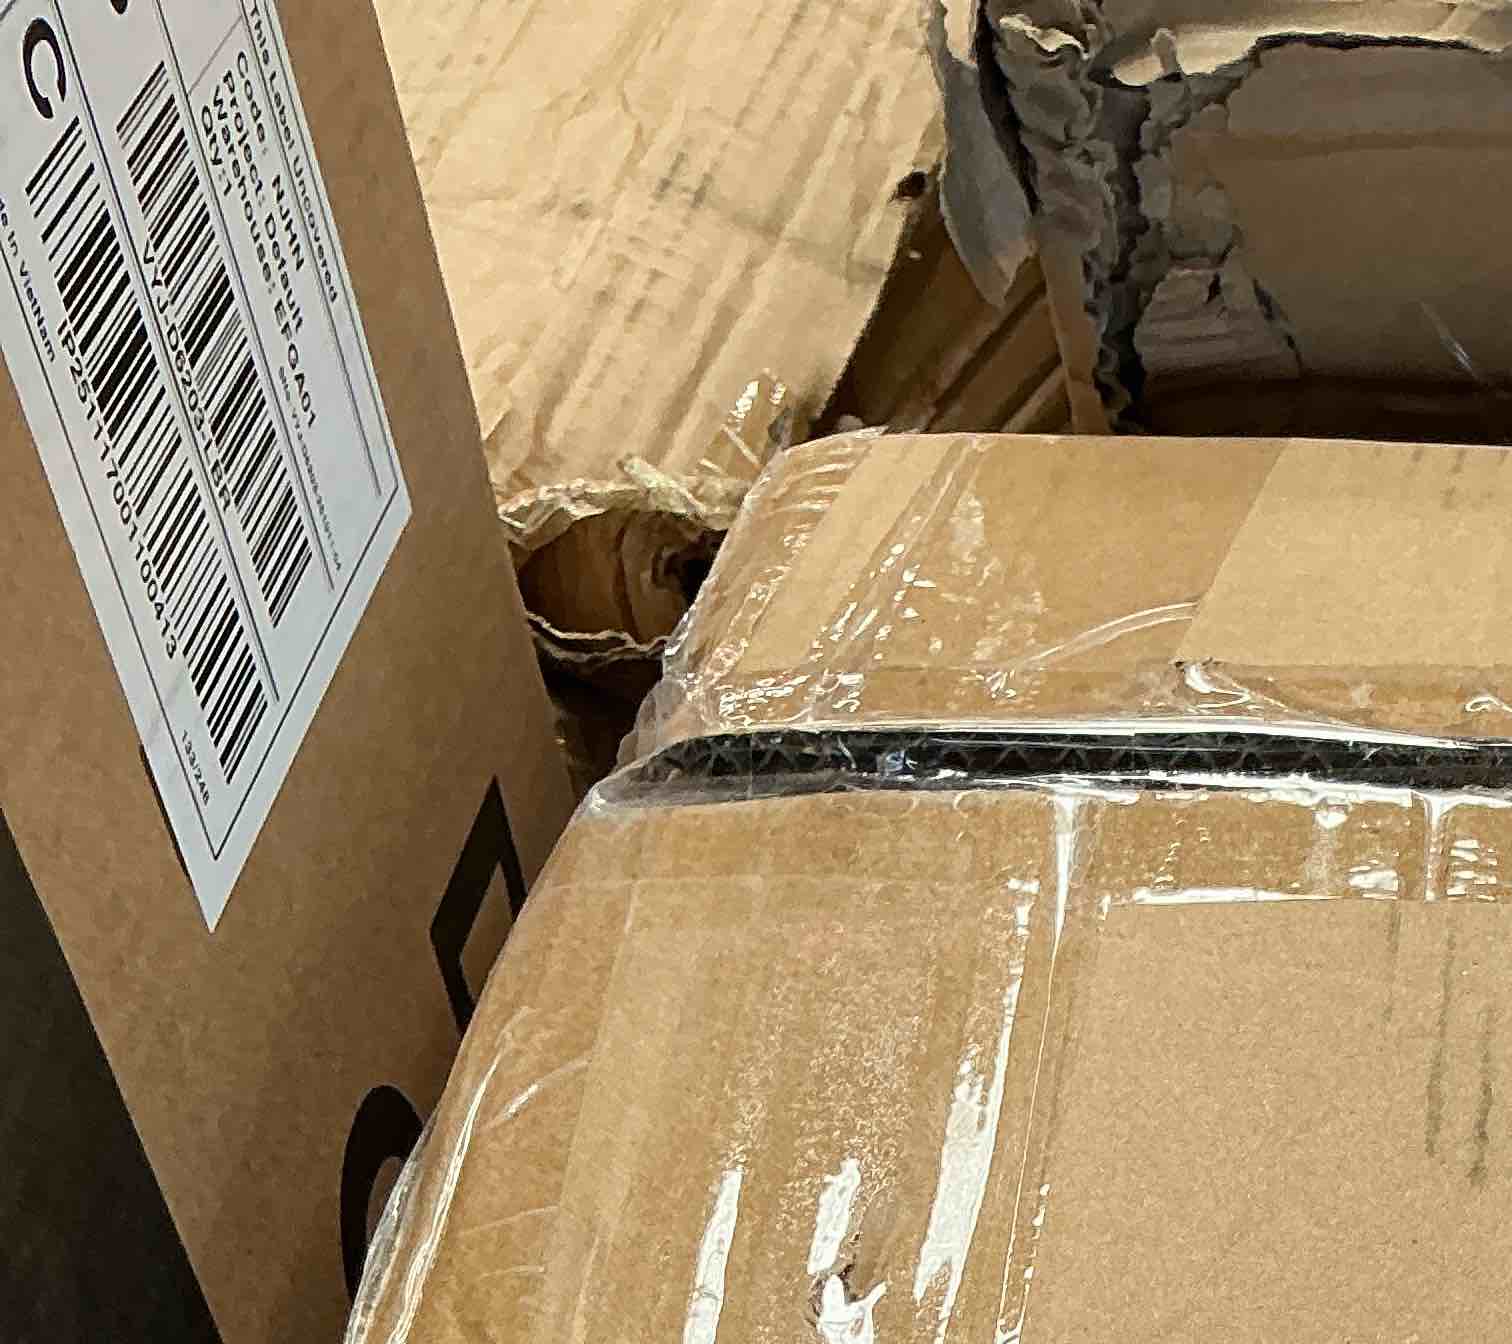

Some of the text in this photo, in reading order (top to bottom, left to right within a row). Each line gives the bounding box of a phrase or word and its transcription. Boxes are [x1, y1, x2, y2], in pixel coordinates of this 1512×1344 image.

[22, 17, 66, 119] C
[237, 51, 305, 271] Code: NJHN
[251, 0, 337, 302] This Label Uncovered
[213, 85, 276, 294] Warehouse:
[223, 70, 303, 331] Project: Default
[20, 260, 56, 362] VietNam
